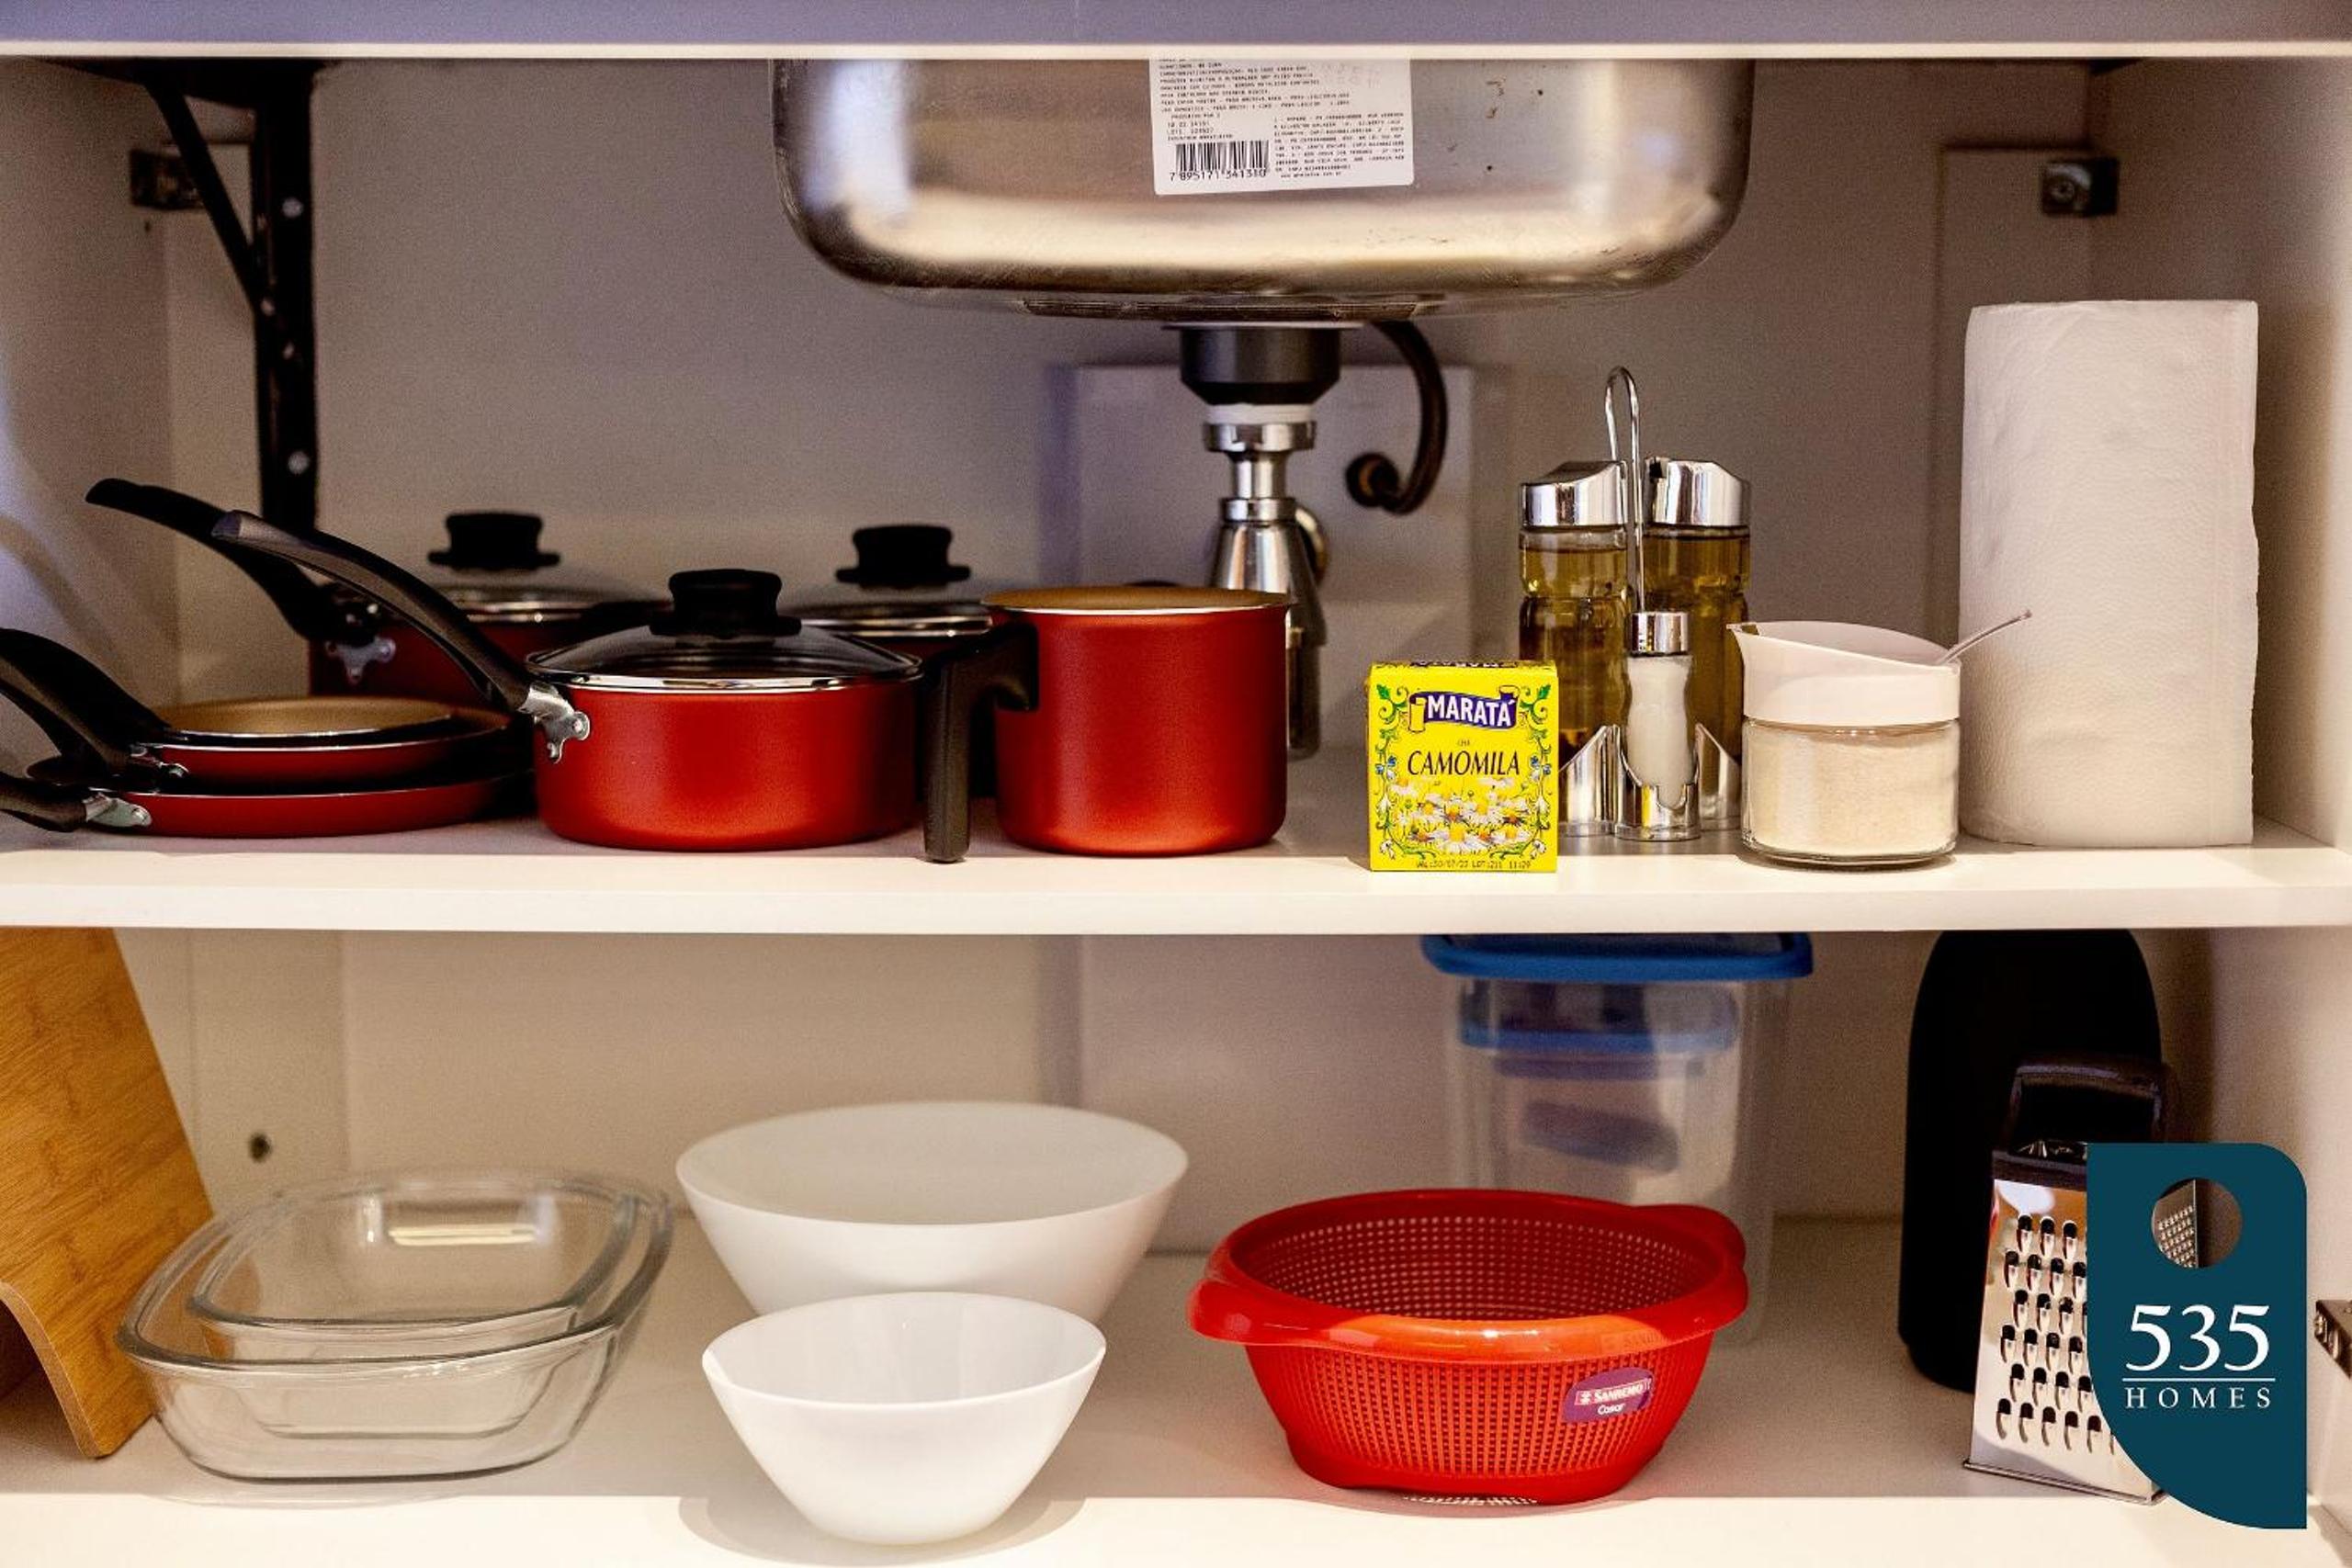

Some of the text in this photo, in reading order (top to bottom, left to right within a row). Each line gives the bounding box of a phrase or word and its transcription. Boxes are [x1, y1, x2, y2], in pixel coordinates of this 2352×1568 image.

[1170, 172, 1176, 182] 7
[1180, 169, 1220, 182] 895171
[1226, 168, 1267, 180] 341310
[1428, 694, 1516, 728] MARATÁ
[1408, 750, 1520, 775] CAMOMILA
[1594, 1382, 1645, 1403] SANREMO
